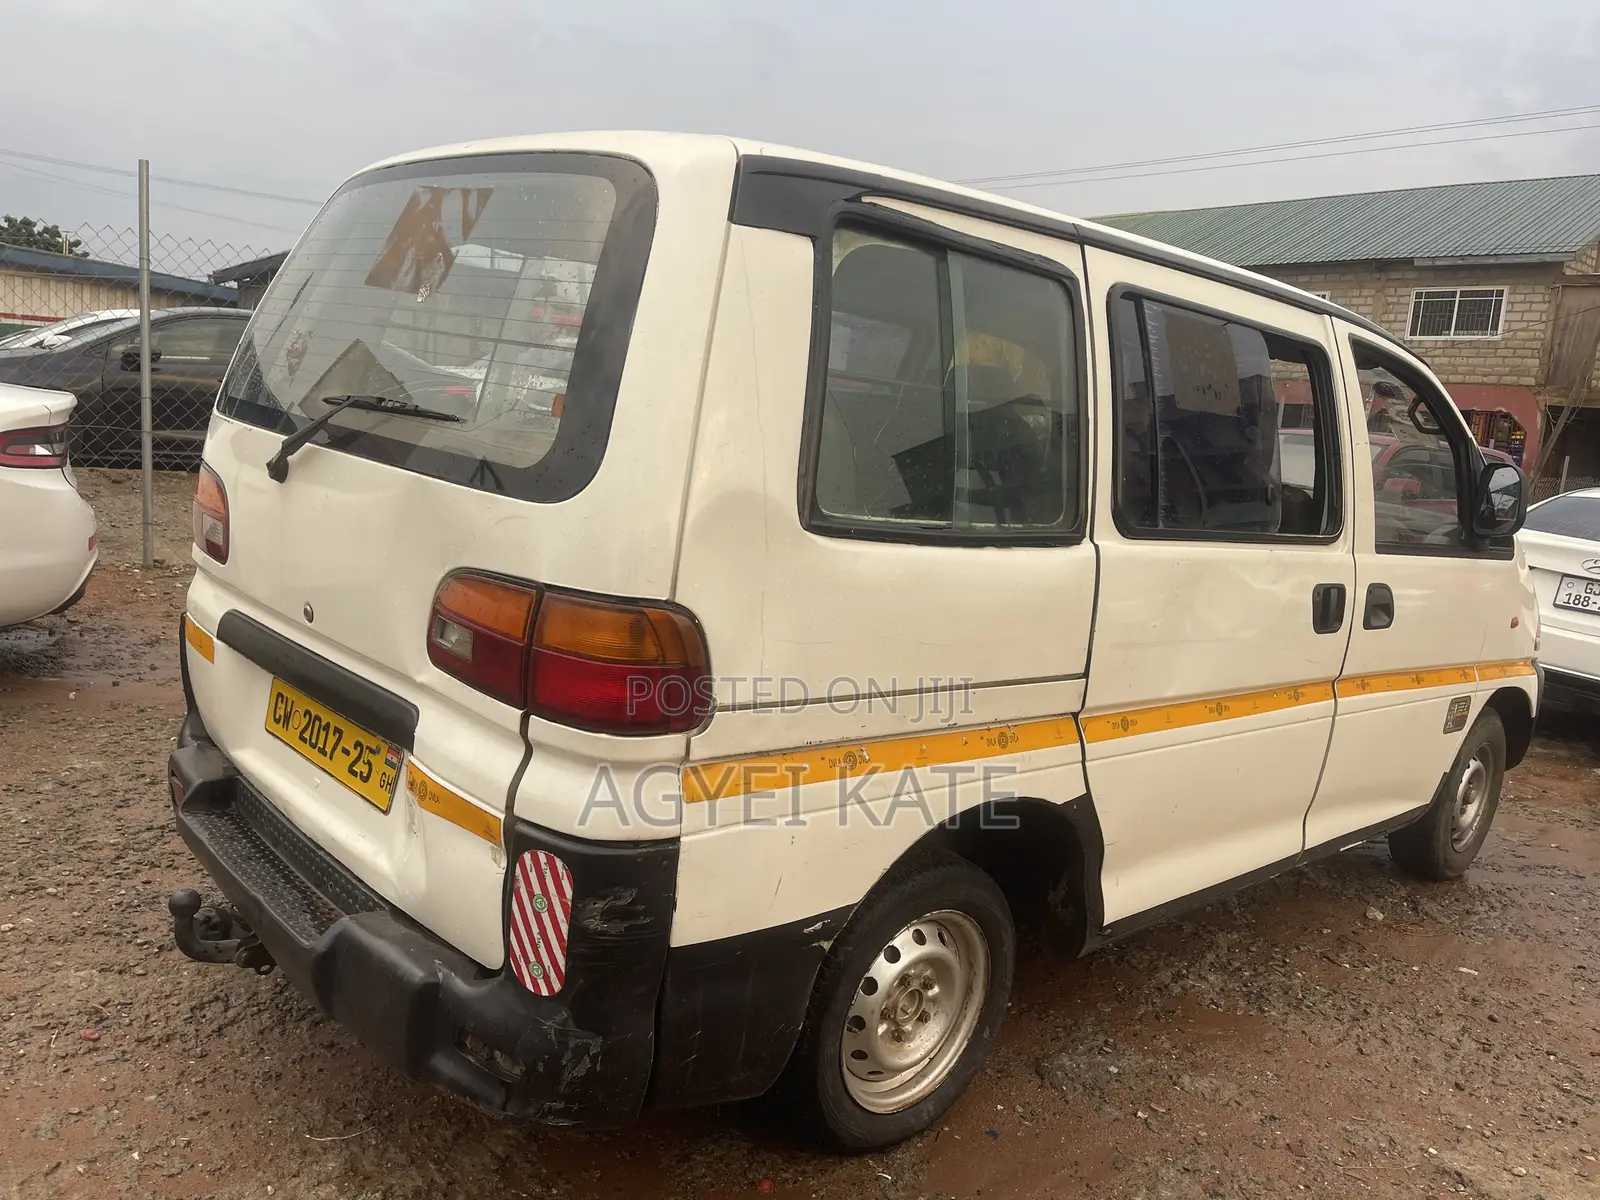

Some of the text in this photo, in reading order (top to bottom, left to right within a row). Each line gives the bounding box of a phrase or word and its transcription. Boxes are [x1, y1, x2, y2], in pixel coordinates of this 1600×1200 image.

[1562, 593, 1600, 610] 188-
[298, 708, 382, 784] 2017-25
[379, 771, 394, 794] GH
